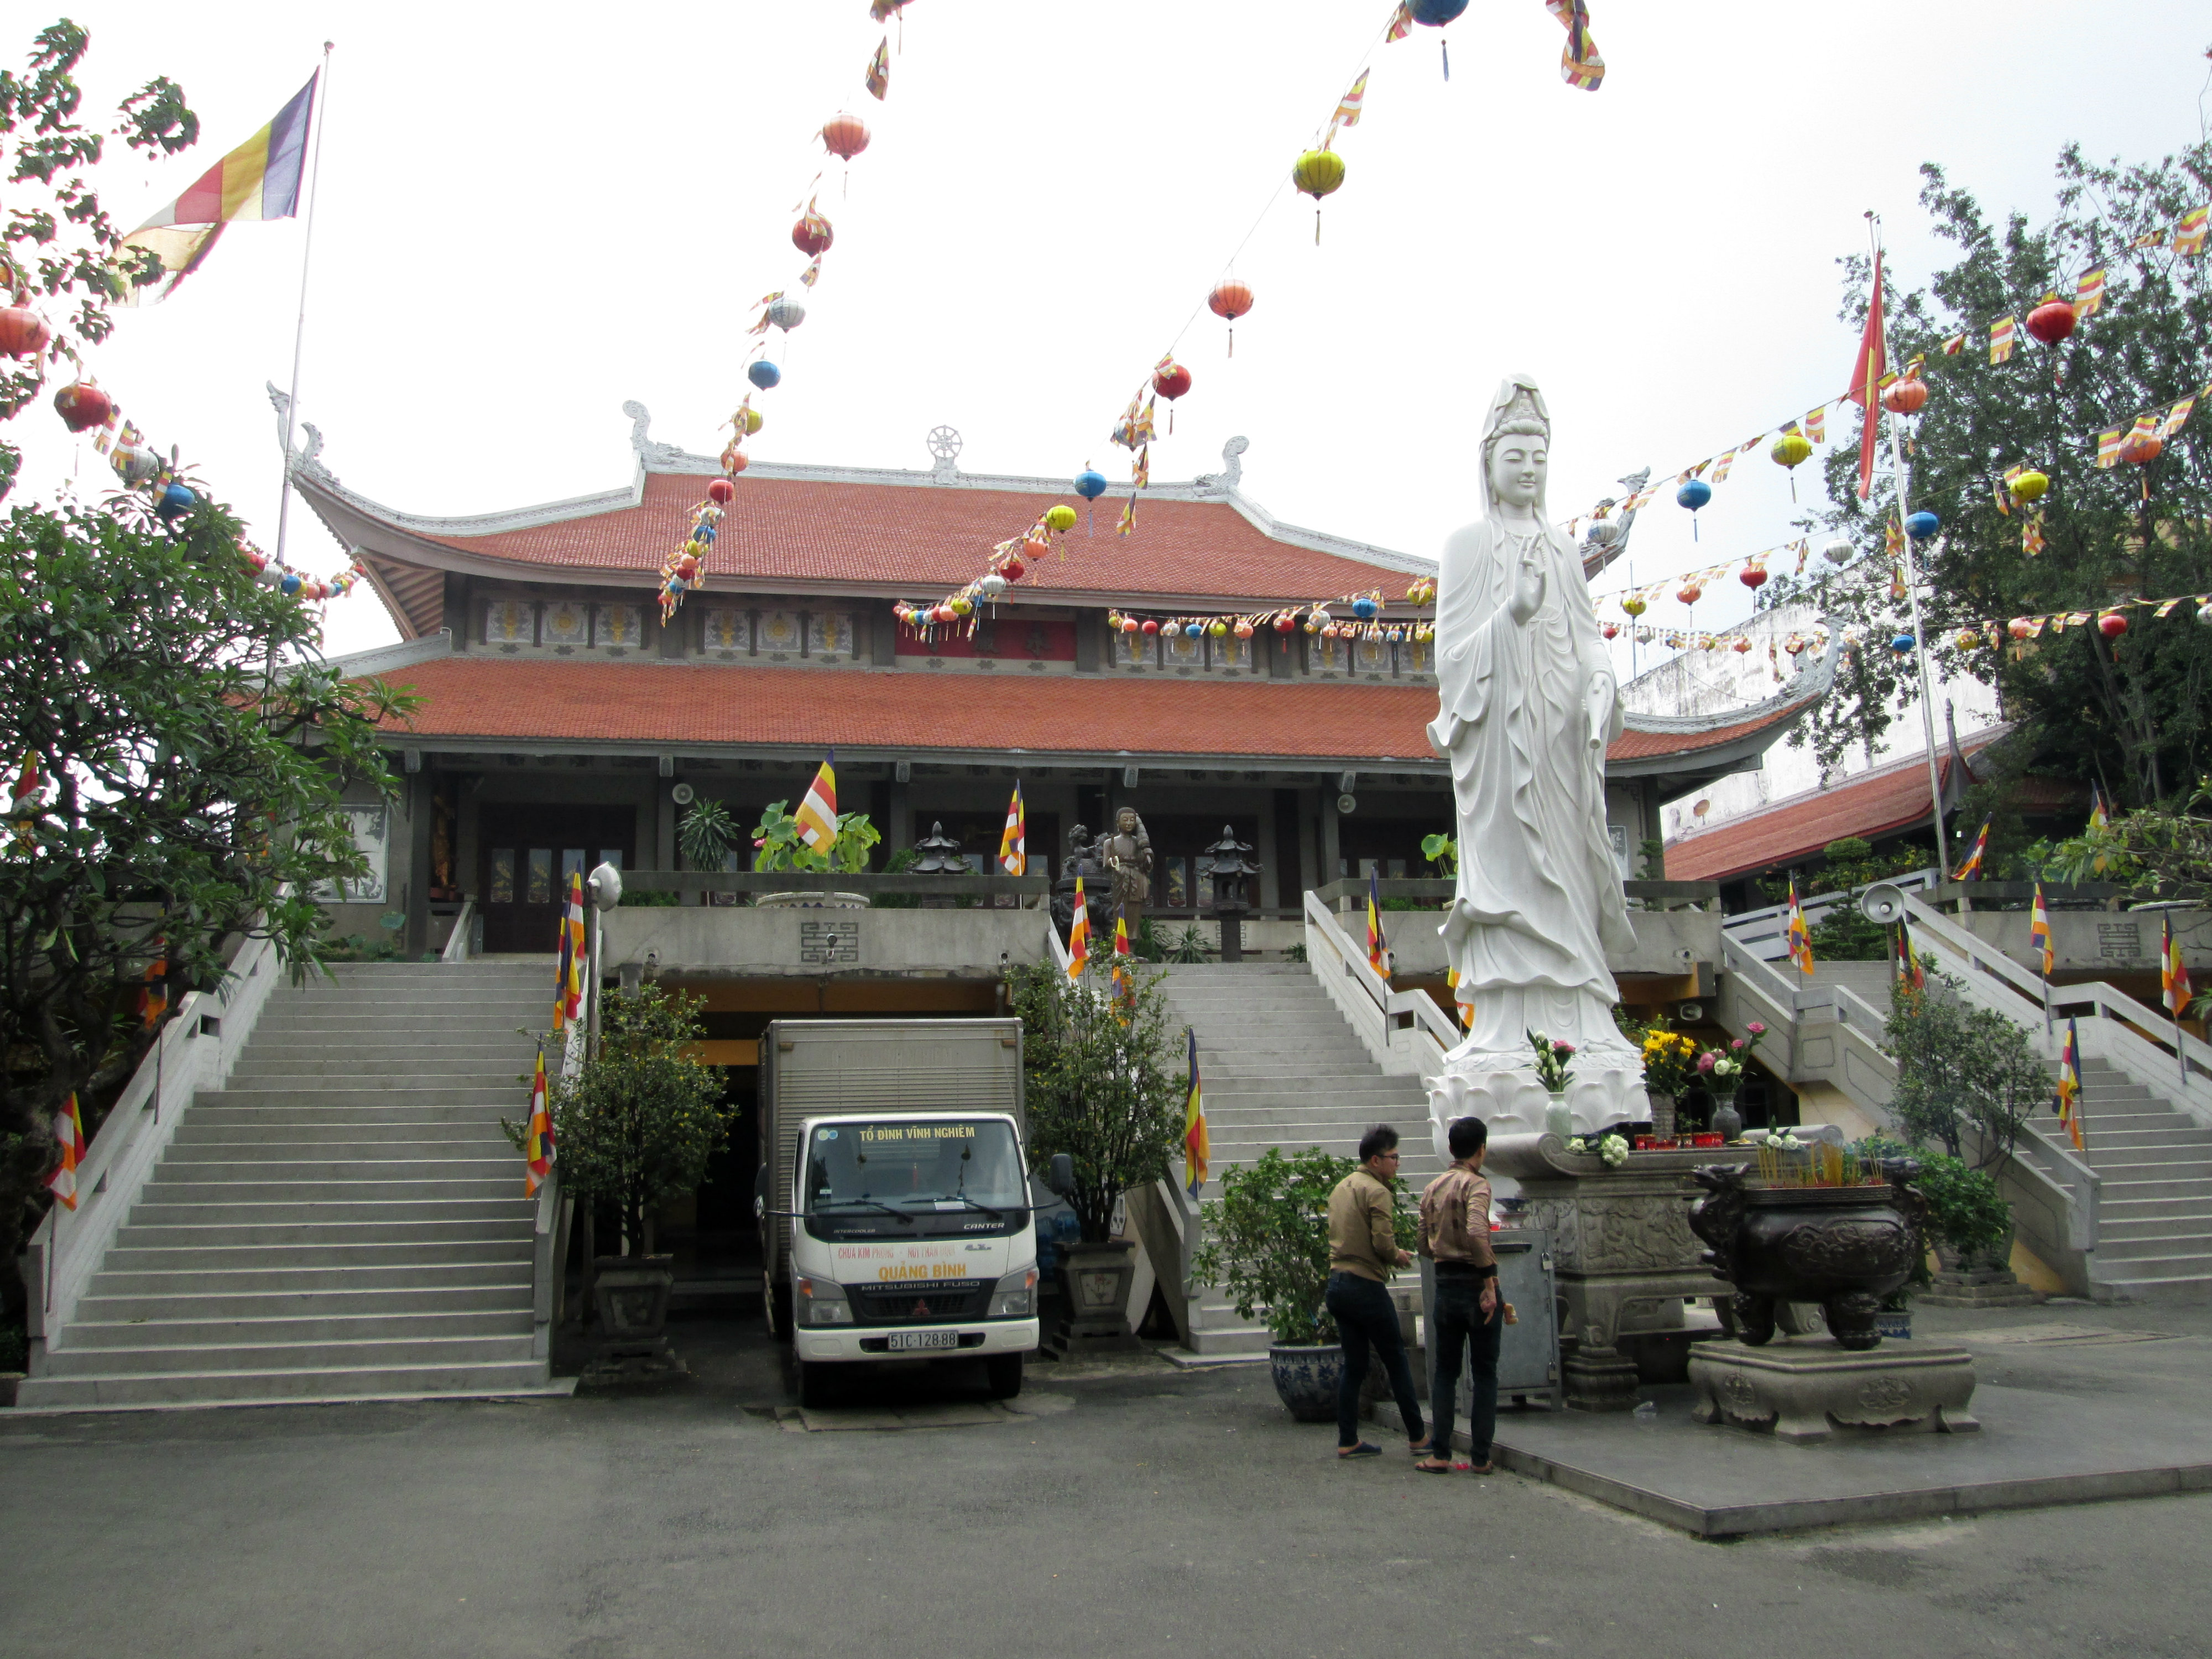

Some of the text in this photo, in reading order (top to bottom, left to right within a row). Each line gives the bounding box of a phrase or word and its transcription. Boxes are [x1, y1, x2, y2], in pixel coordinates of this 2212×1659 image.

[859, 1124, 975, 1141] TỔ ĐÌNH VĨNH NGHIÊM
[858, 1247, 870, 1259] KIM
[878, 1260, 967, 1282] QUẢNG BÌNH
[861, 1282, 939, 1291] MITSUBISHI
